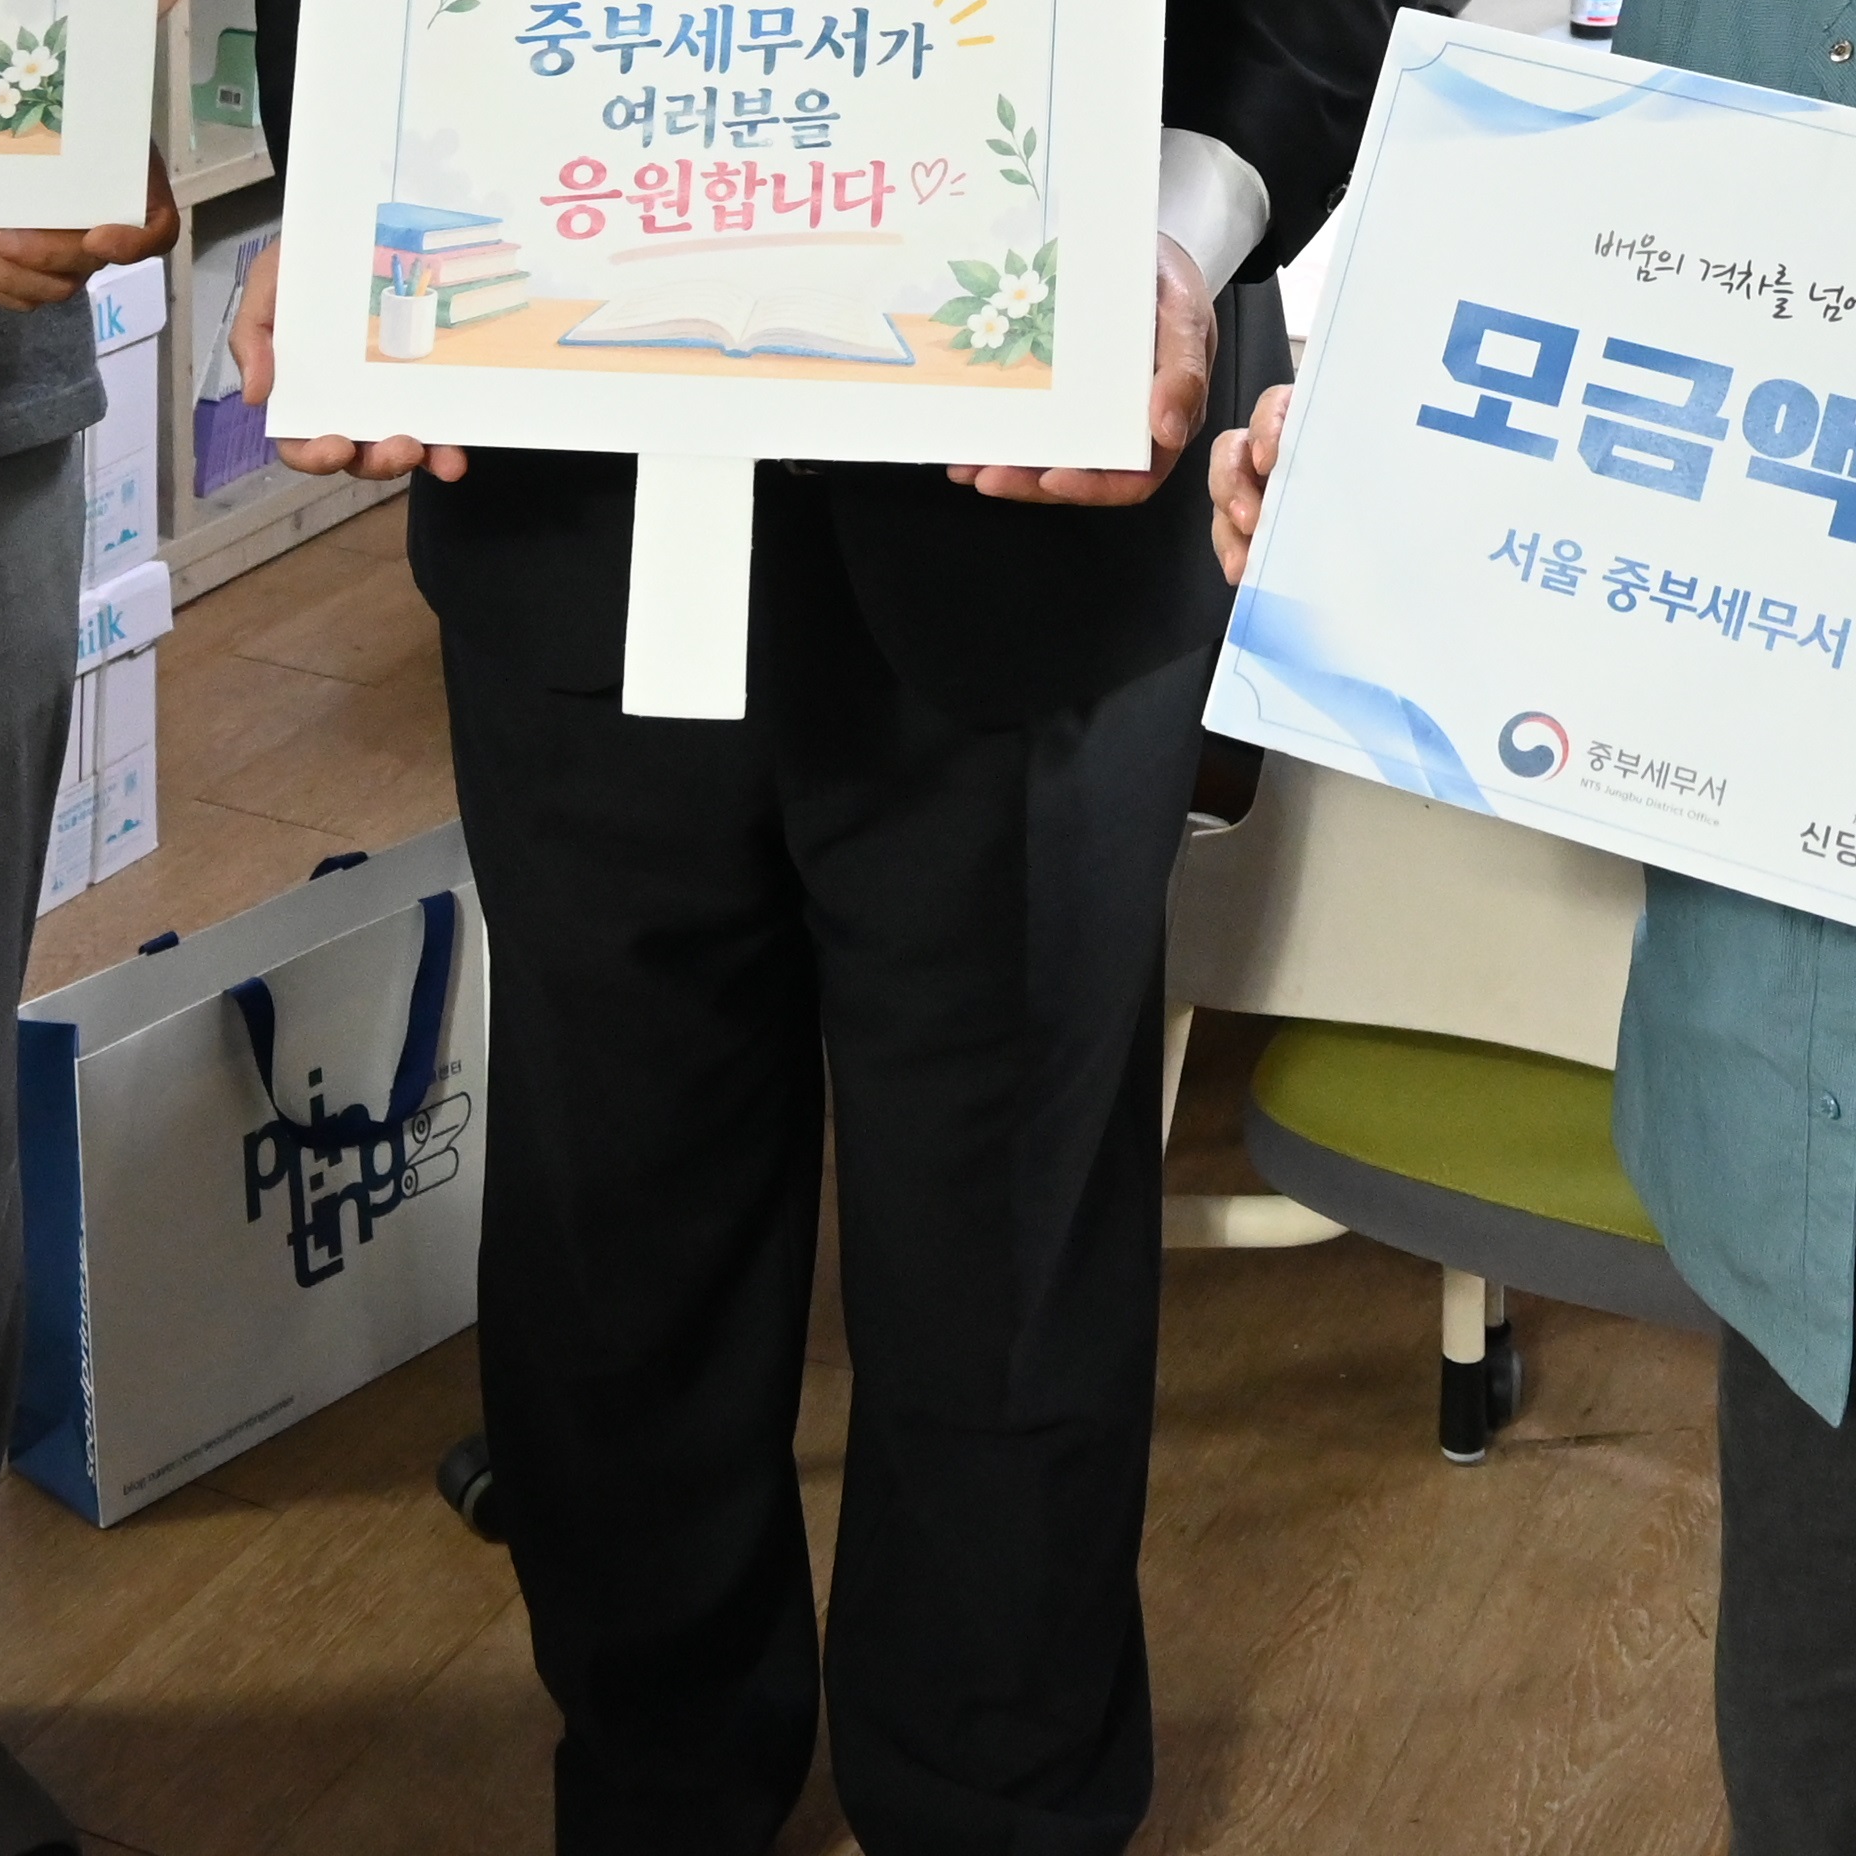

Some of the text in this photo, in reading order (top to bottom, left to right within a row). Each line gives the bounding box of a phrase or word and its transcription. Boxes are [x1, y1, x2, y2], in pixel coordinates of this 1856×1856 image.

[515, 0, 934, 79] 중부세무서가
[602, 86, 841, 150] 여러분을
[540, 155, 896, 240] 응원합니다
[1594, 230, 1685, 283] 배움의
[1699, 258, 1794, 319] 격차를
[1488, 526, 1587, 598] 서울
[1601, 556, 1849, 669] 중부세무서
[1579, 777, 1721, 828] NTS Jungbu District Office
[1586, 739, 1727, 807] 중부세무서
